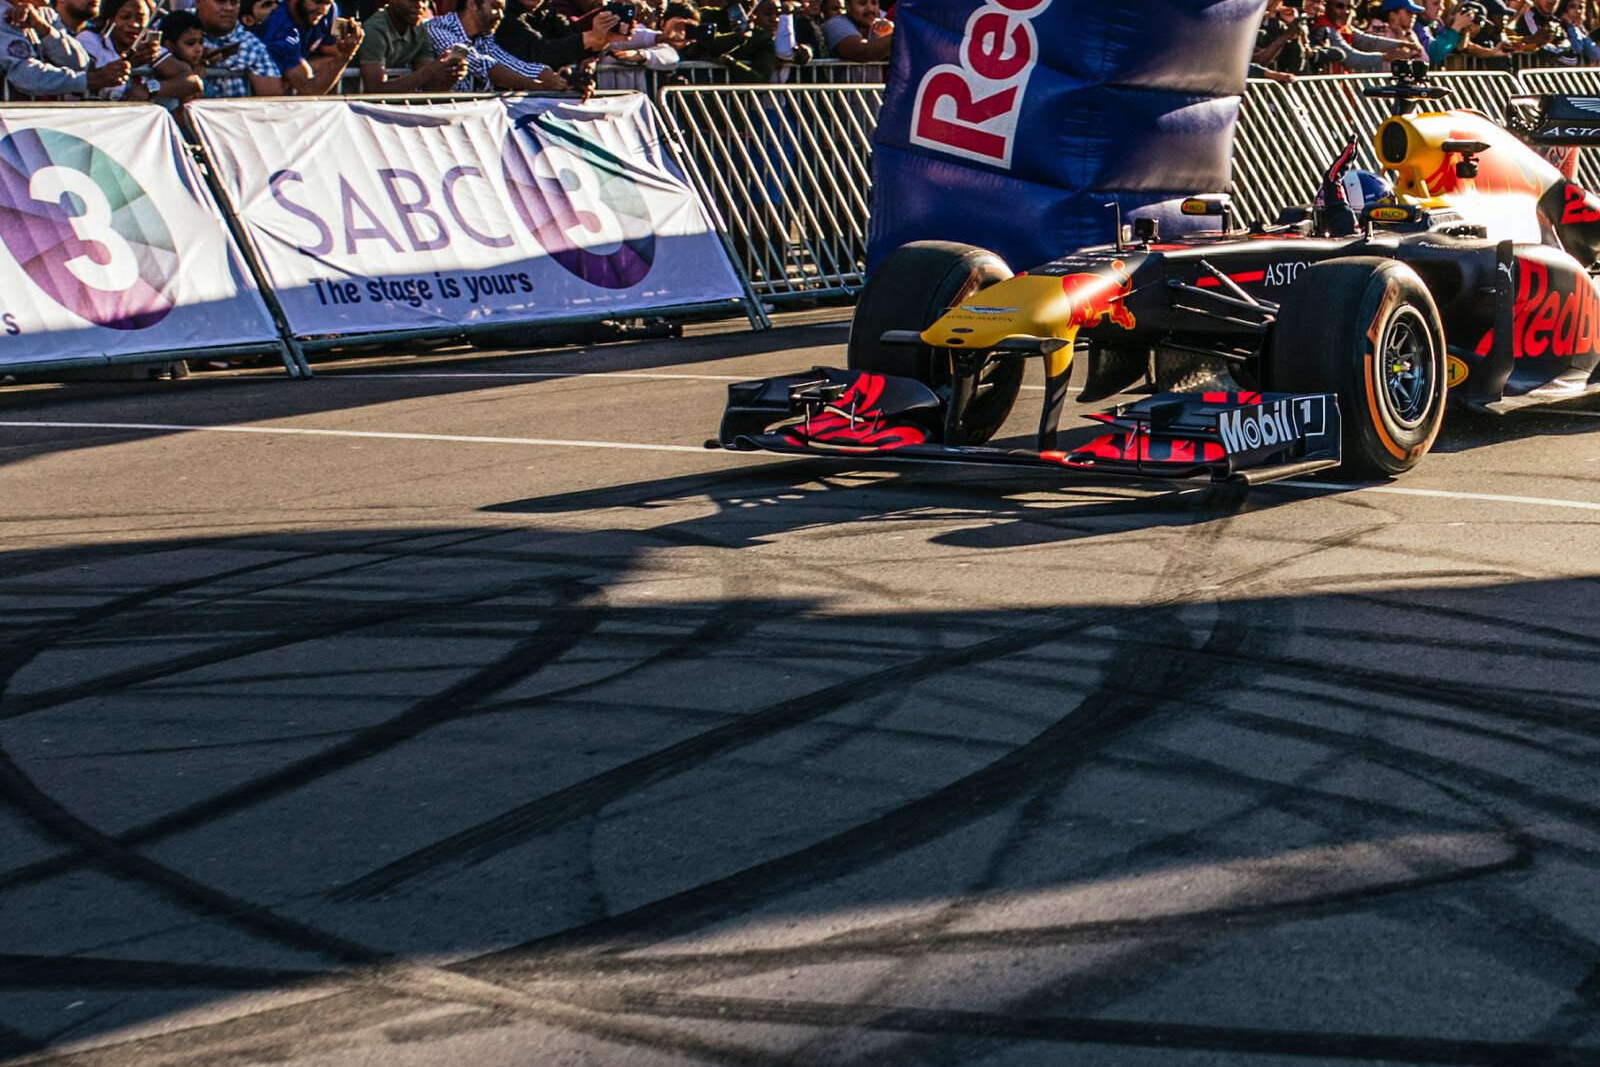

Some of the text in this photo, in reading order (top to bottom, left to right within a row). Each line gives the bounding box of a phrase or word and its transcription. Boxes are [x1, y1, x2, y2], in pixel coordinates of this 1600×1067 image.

[30, 165, 140, 291] 3
[268, 145, 624, 257] SABC 3
[309, 270, 534, 308] The stage is yours
[1264, 261, 1311, 286] ASTO
[1220, 400, 1293, 454] Mobil
